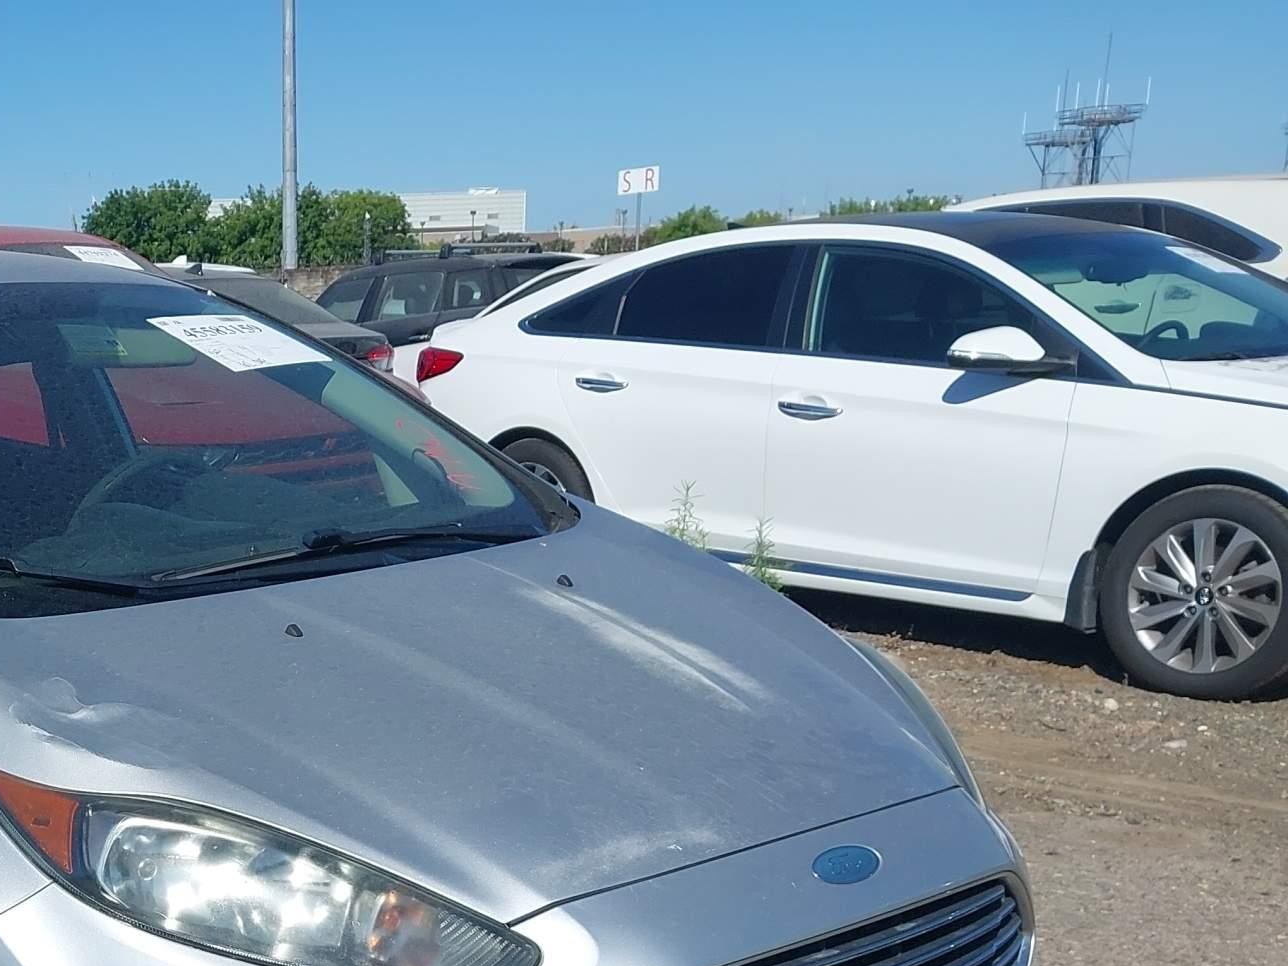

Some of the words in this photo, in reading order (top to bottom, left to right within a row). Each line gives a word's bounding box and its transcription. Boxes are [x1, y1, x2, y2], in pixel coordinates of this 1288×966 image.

[622, 170, 632, 193] S
[644, 167, 655, 191] R
[183, 324, 263, 338] 45583159
